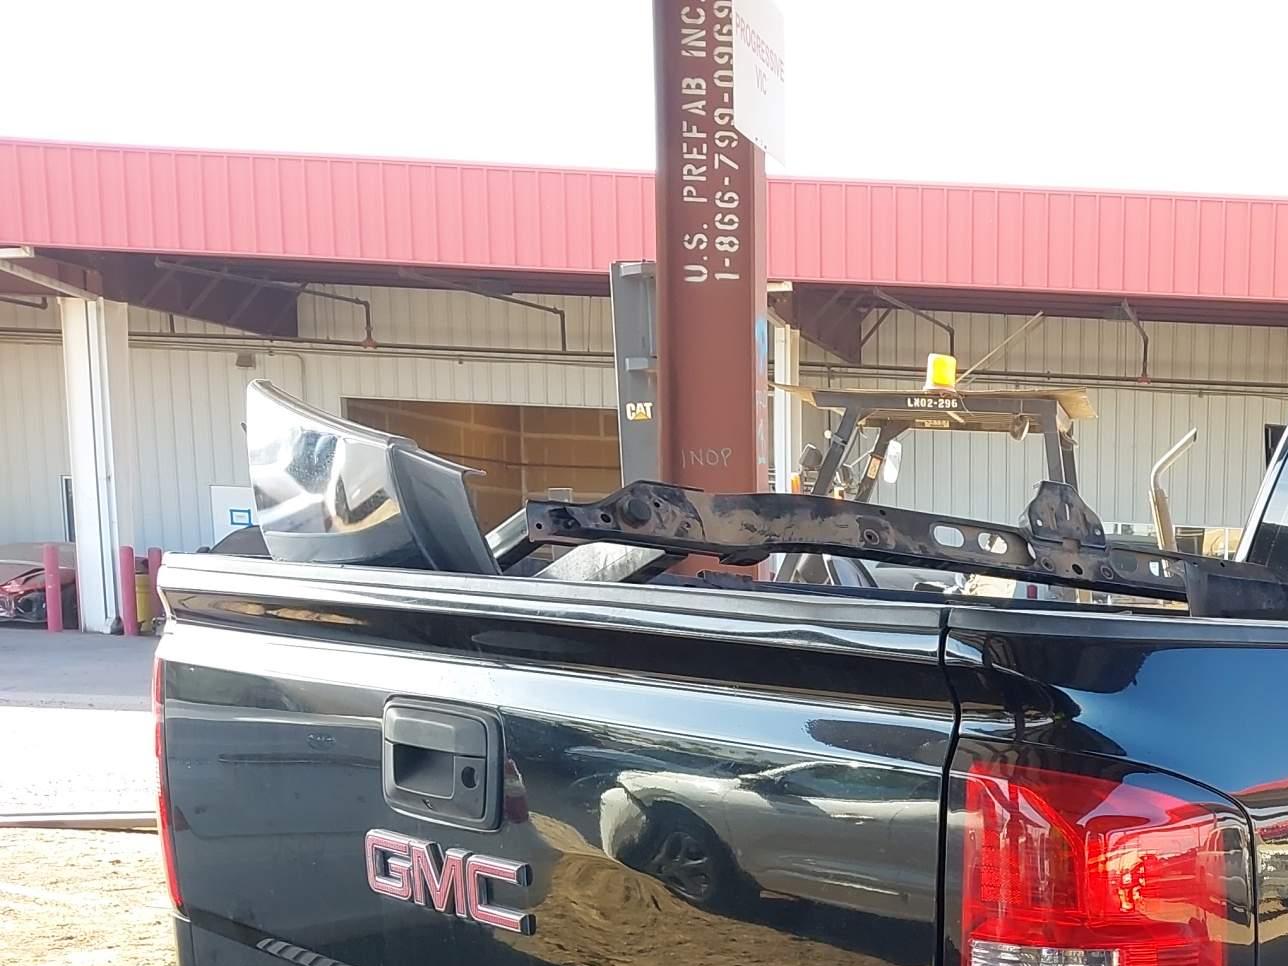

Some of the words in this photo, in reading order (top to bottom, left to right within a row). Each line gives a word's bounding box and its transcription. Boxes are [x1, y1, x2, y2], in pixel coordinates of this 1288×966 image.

[682, 77, 709, 203] PREFAB
[684, 222, 709, 283] U.S.
[625, 402, 654, 421] CAT
[681, 447, 732, 470] INOP
[365, 828, 537, 936] GMC
